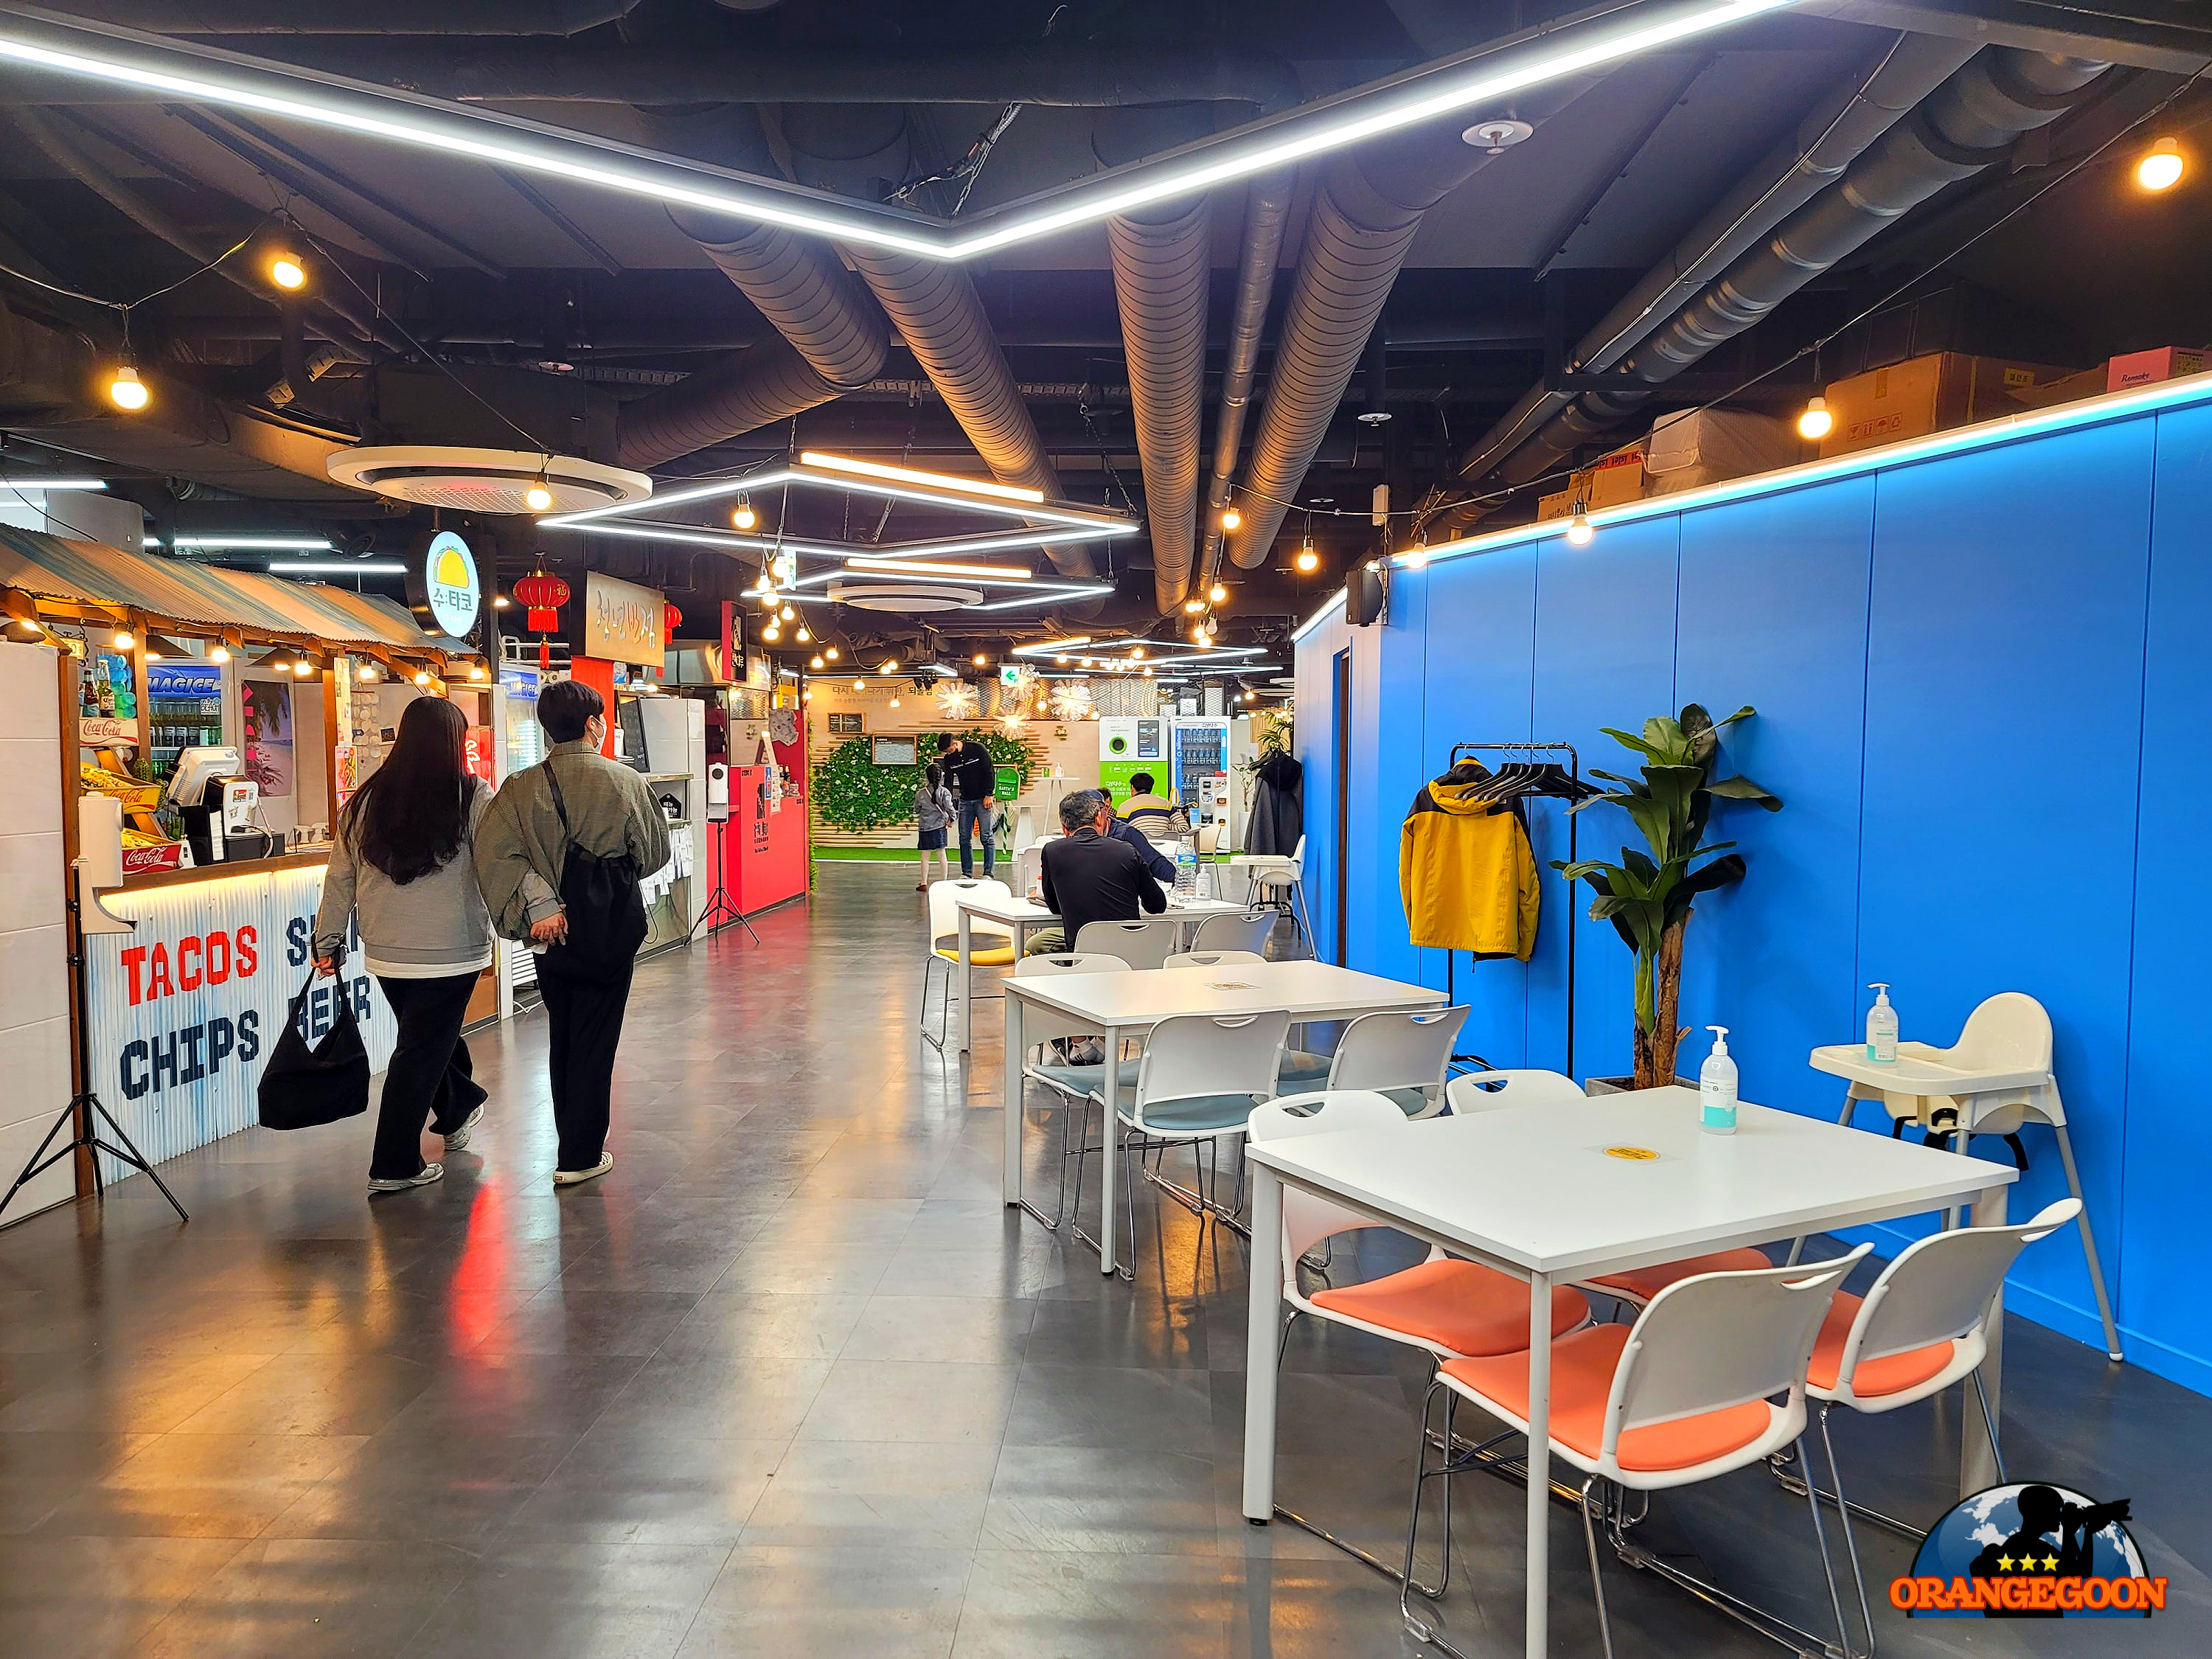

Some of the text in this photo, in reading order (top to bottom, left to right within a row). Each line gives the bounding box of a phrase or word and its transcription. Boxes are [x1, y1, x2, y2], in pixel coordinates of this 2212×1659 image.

[832, 686, 847, 695] 다시
[83, 720, 122, 737] Coca-Cola
[125, 846, 167, 866] Coca-Cola
[121, 925, 257, 1006] TACOS
[120, 1009, 259, 1100] CHIPS
